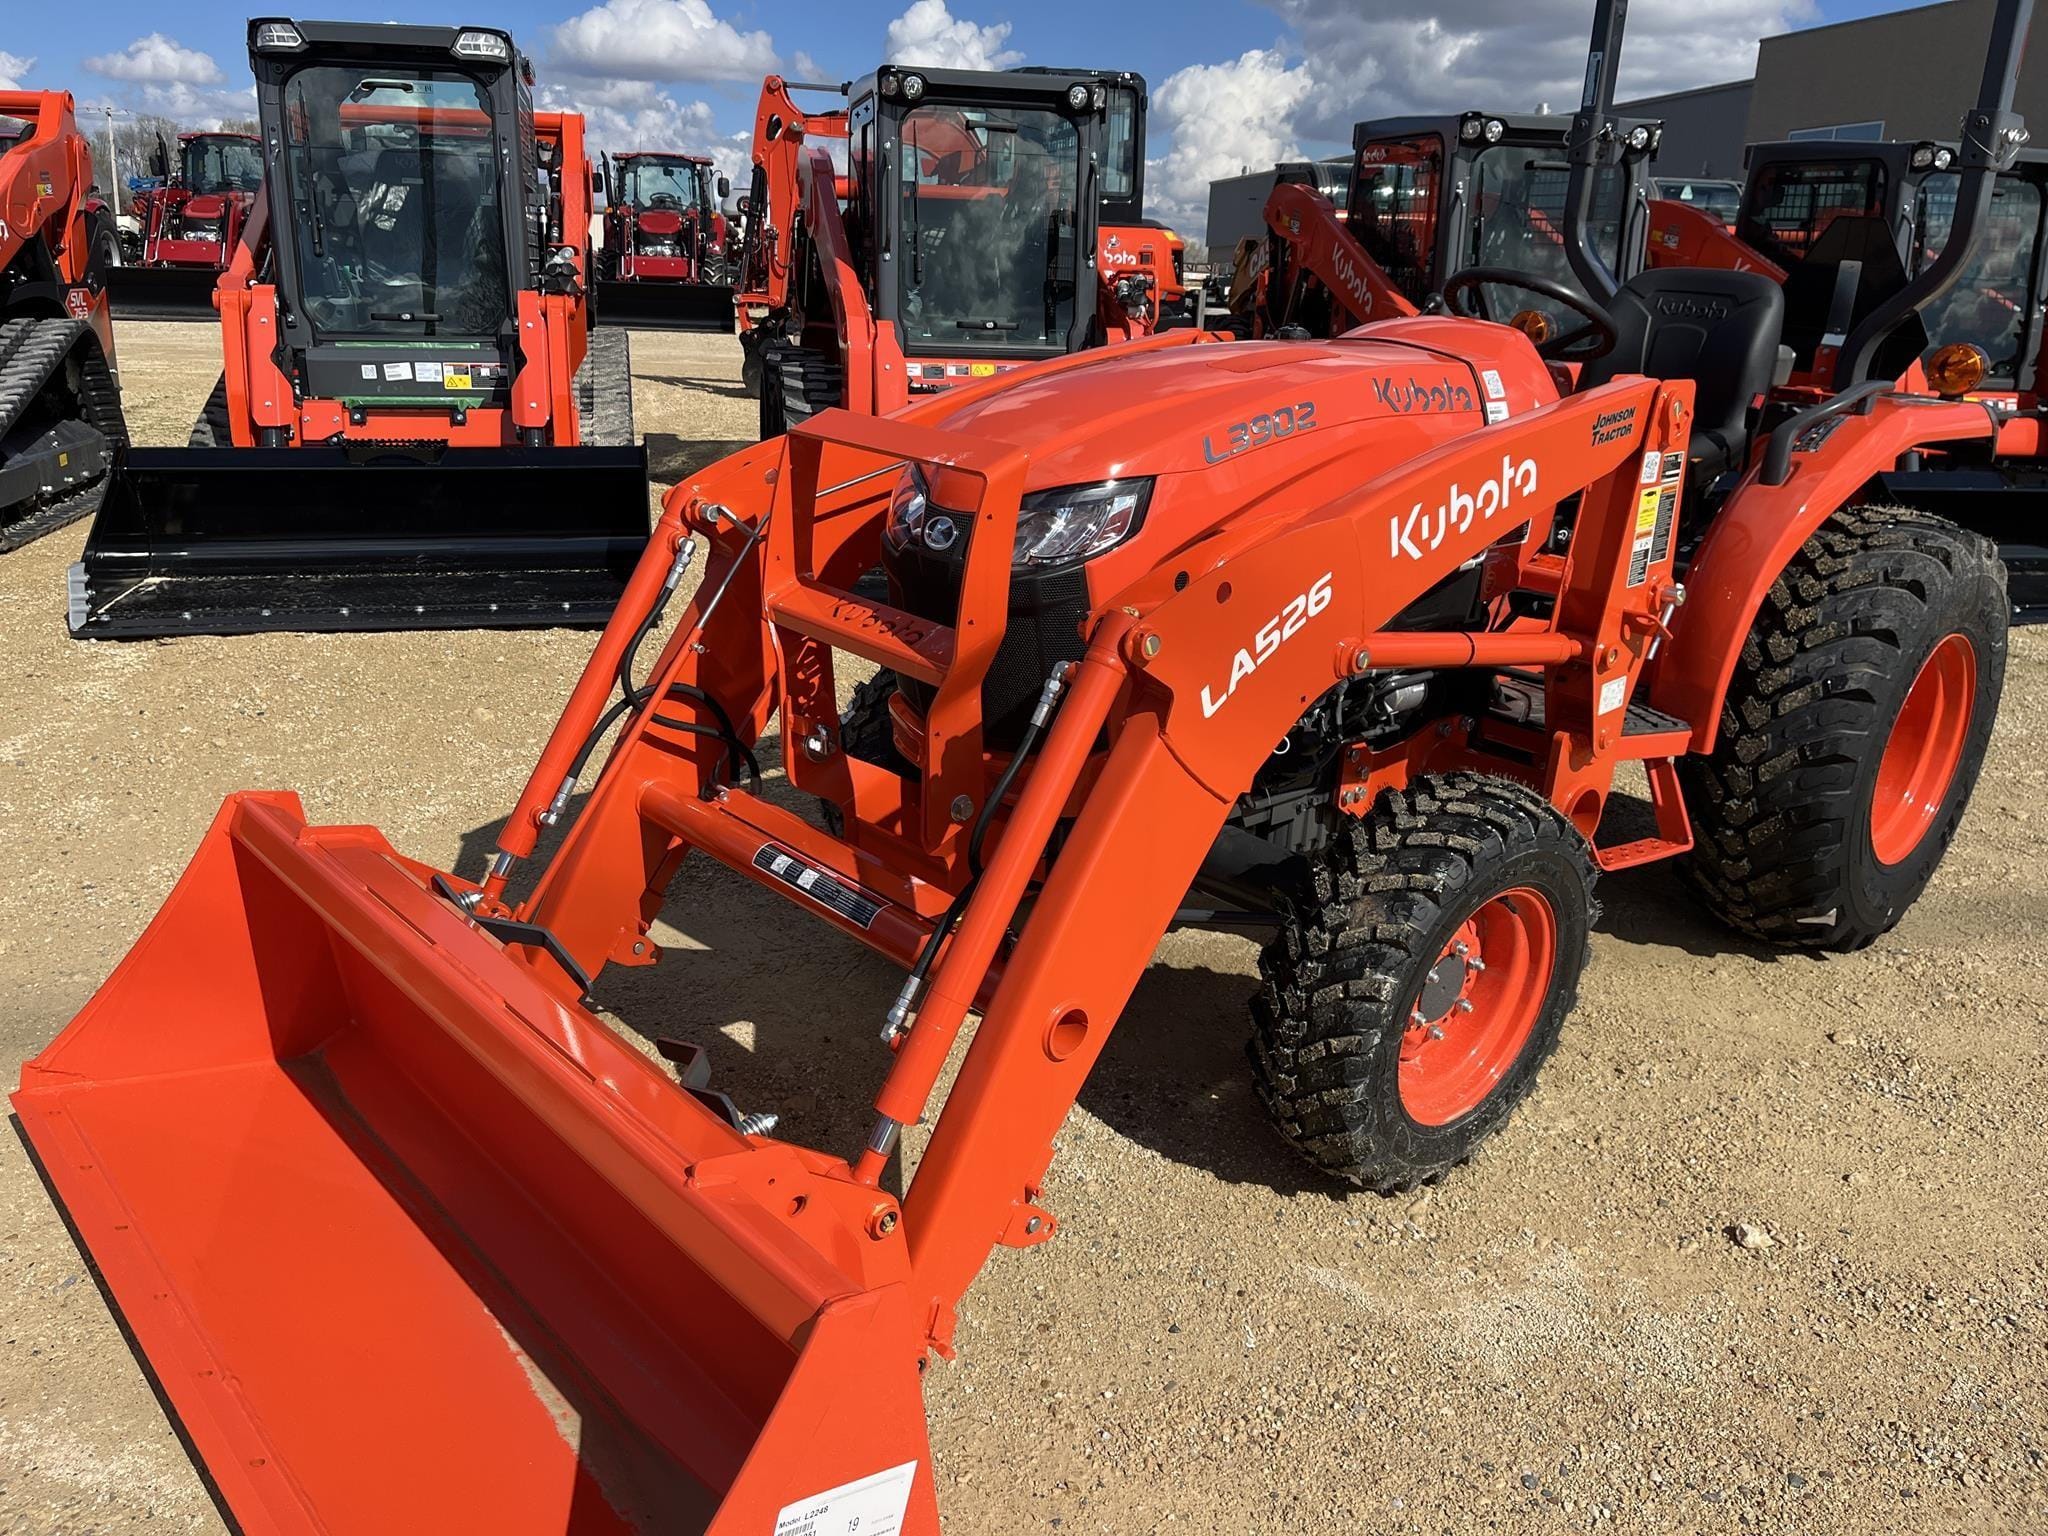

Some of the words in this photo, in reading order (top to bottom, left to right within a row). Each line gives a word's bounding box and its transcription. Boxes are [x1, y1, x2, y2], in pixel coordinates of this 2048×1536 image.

[1332, 242, 1373, 315] Kubota
[70, 292, 87, 307] SVL
[1372, 377, 1473, 413] Kubota
[1203, 401, 1317, 465] L3902
[1591, 423, 1633, 447] TRACTOR
[1592, 406, 1637, 431] JOHNSON
[1390, 454, 1537, 561] Kubota
[1200, 571, 1333, 719] LA526
[847, 1516, 860, 1533] 19
